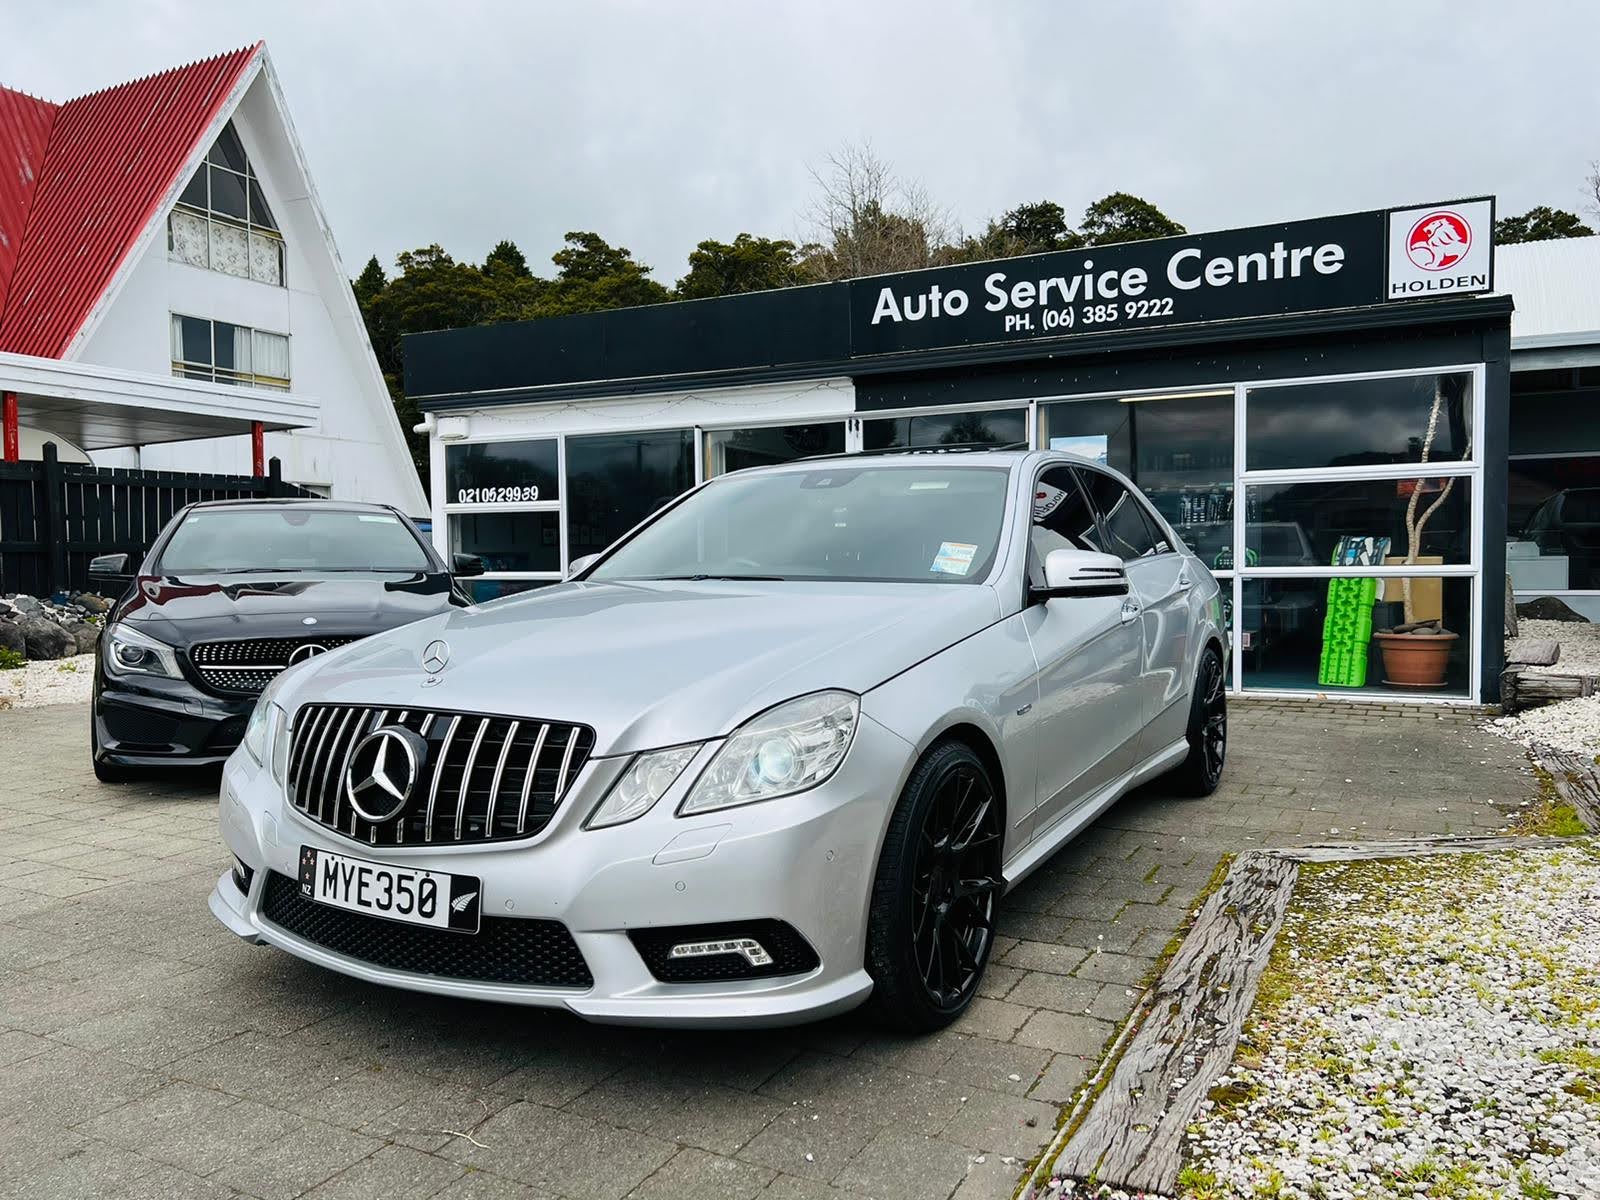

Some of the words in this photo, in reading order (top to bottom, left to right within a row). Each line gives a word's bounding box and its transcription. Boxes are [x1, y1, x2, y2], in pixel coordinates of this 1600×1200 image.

[871, 285, 969, 325] Auto
[984, 259, 1149, 312] Service
[1166, 241, 1345, 291] Centre
[1392, 274, 1486, 294] HOLDEN
[1005, 313, 1035, 333] PH.
[1042, 307, 1075, 331] (06)
[1082, 303, 1119, 325] 385
[1124, 297, 1174, 320] 9222
[301, 883, 312, 896] NZ
[322, 858, 438, 919] MYE350
